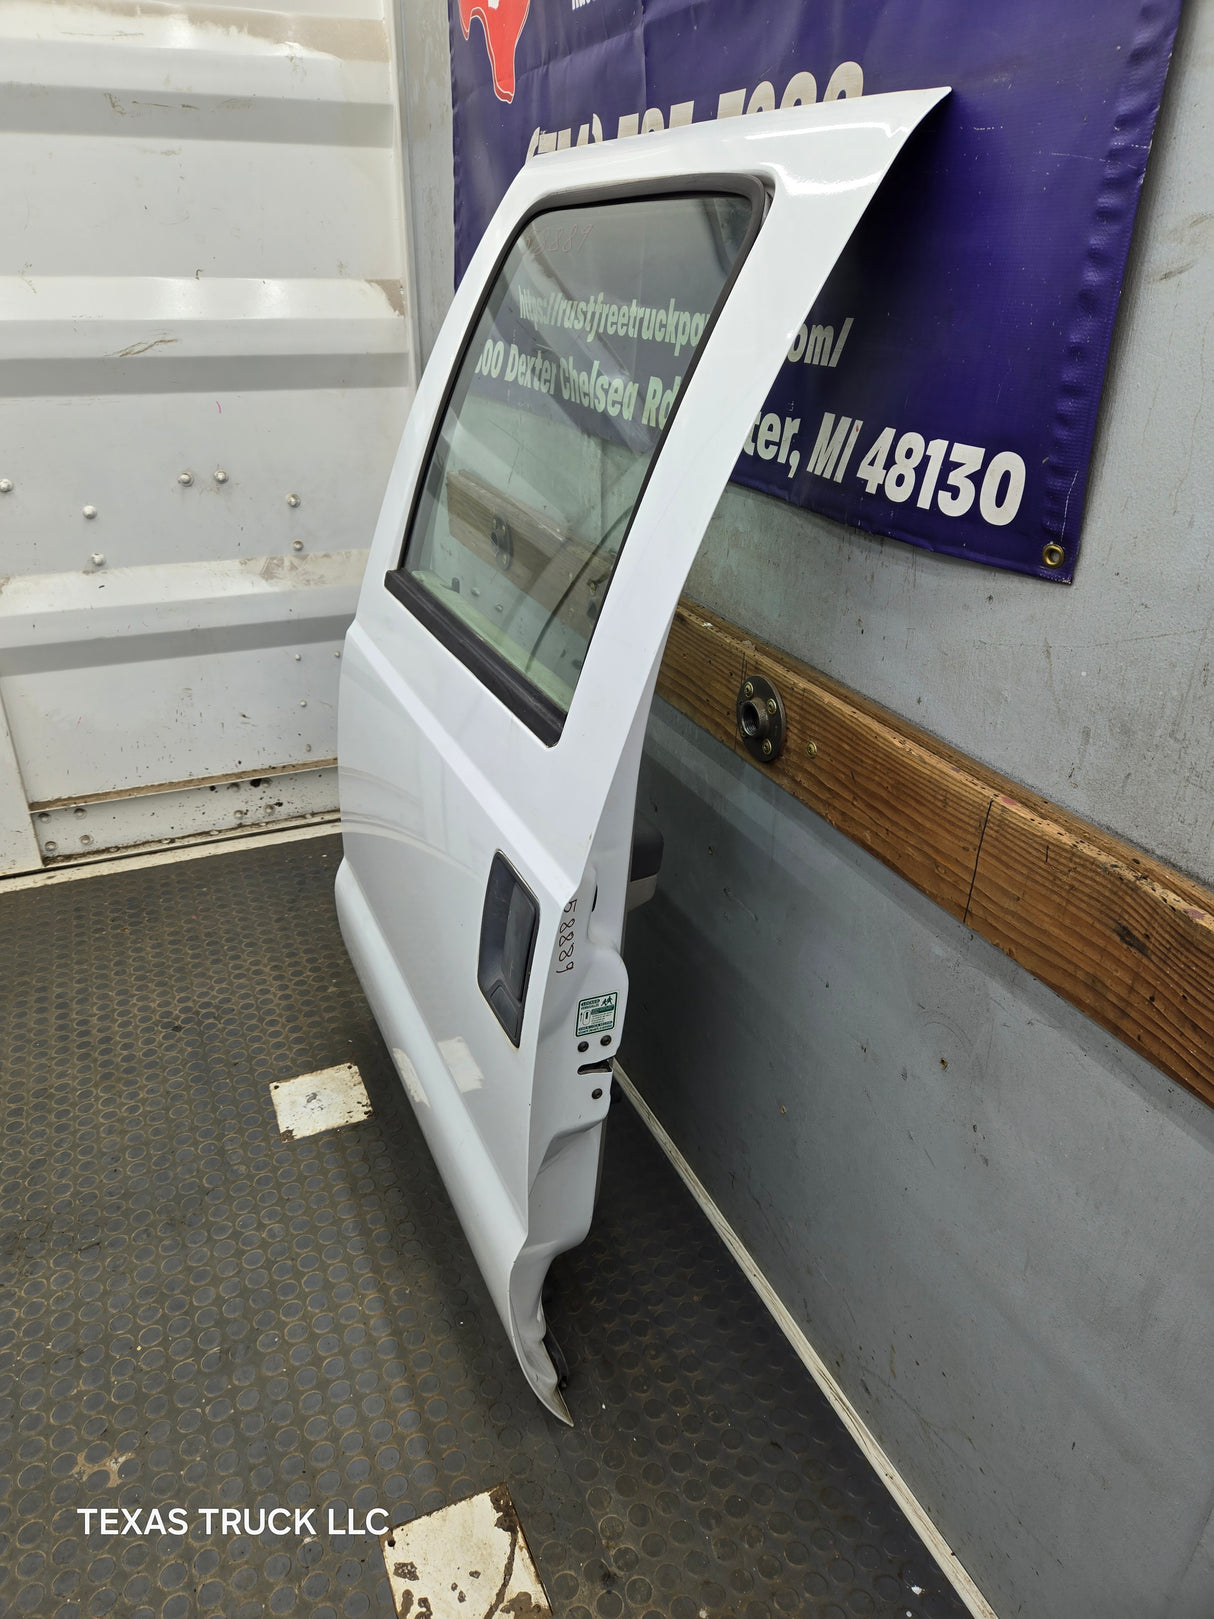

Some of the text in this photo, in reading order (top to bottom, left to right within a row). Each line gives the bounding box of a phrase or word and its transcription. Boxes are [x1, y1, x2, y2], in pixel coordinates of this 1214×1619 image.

[504, 344, 557, 395] Dexter
[559, 356, 640, 421] Chelsea
[806, 412, 864, 484] MI
[856, 427, 1026, 526] 48130
